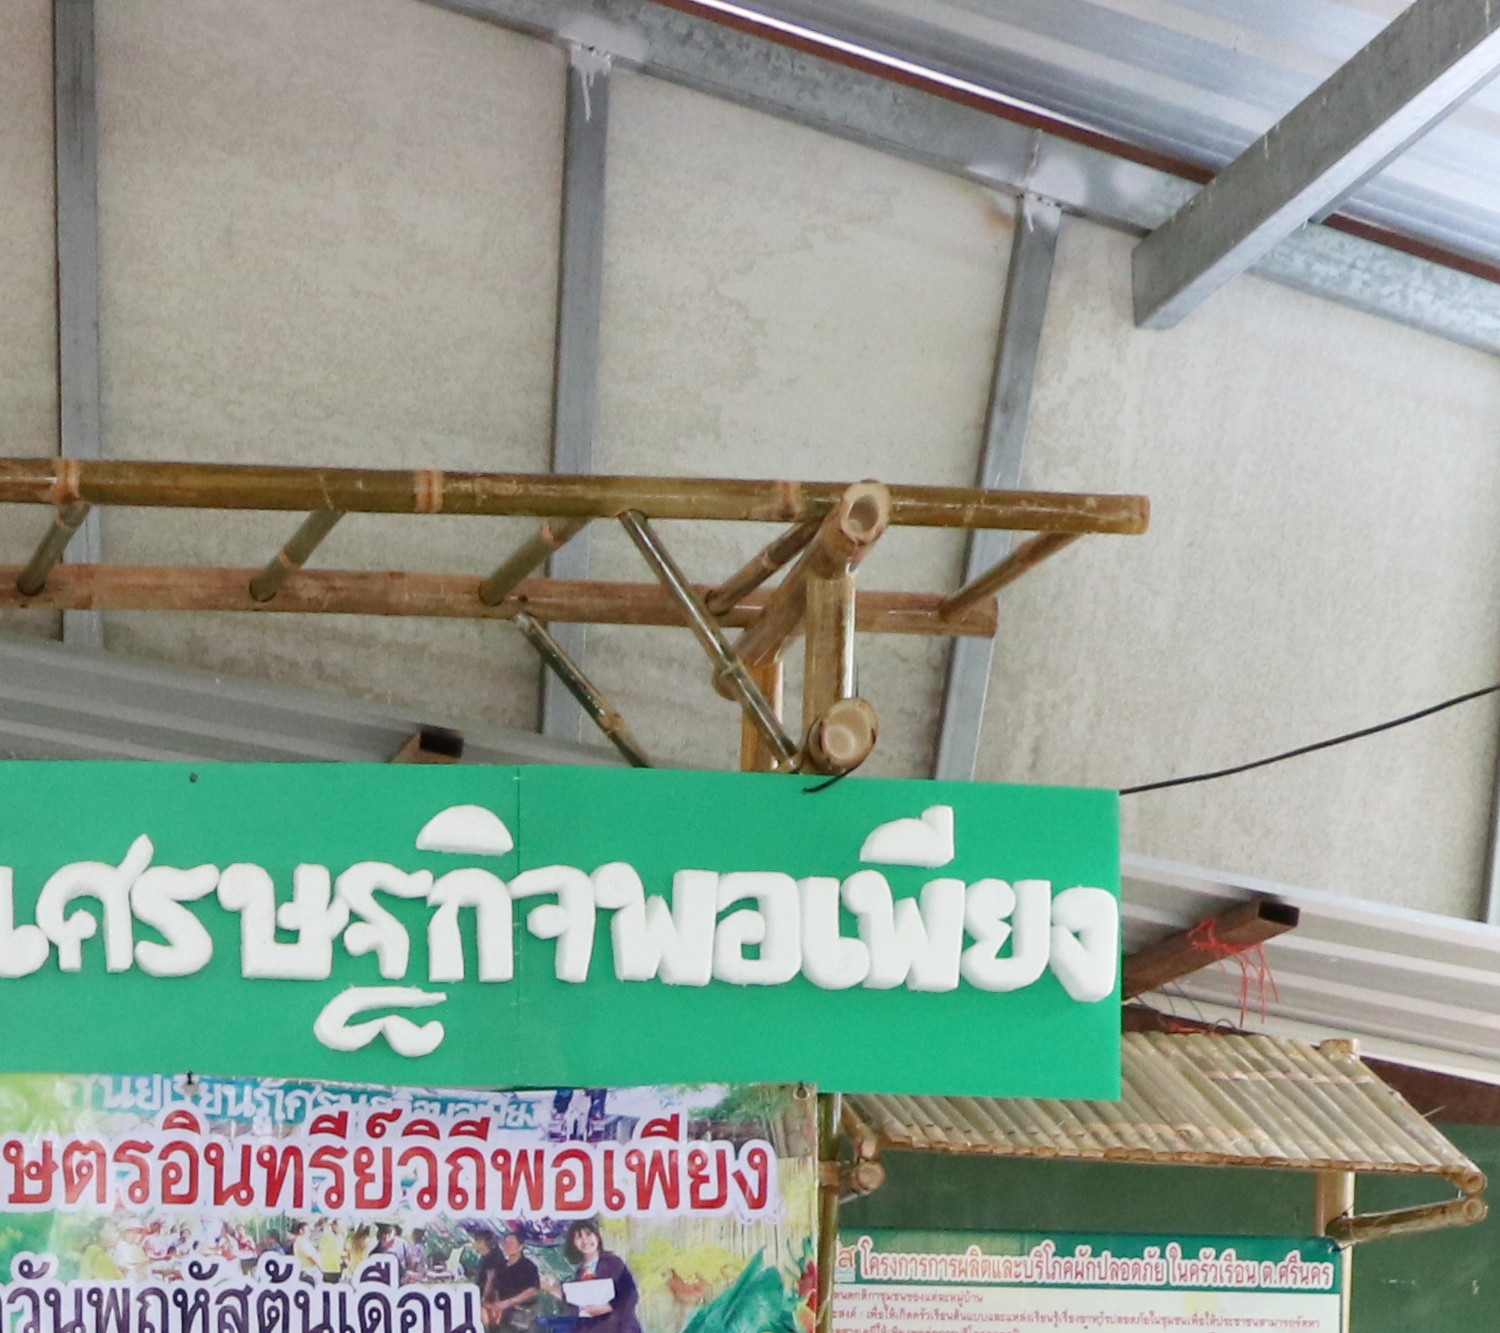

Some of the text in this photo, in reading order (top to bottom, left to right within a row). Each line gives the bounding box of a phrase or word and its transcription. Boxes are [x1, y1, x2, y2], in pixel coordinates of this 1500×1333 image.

[1169, 1245, 1258, 1285] ในครัวเรือน
[1261, 1251, 1331, 1287] ต.ศรีนคร
